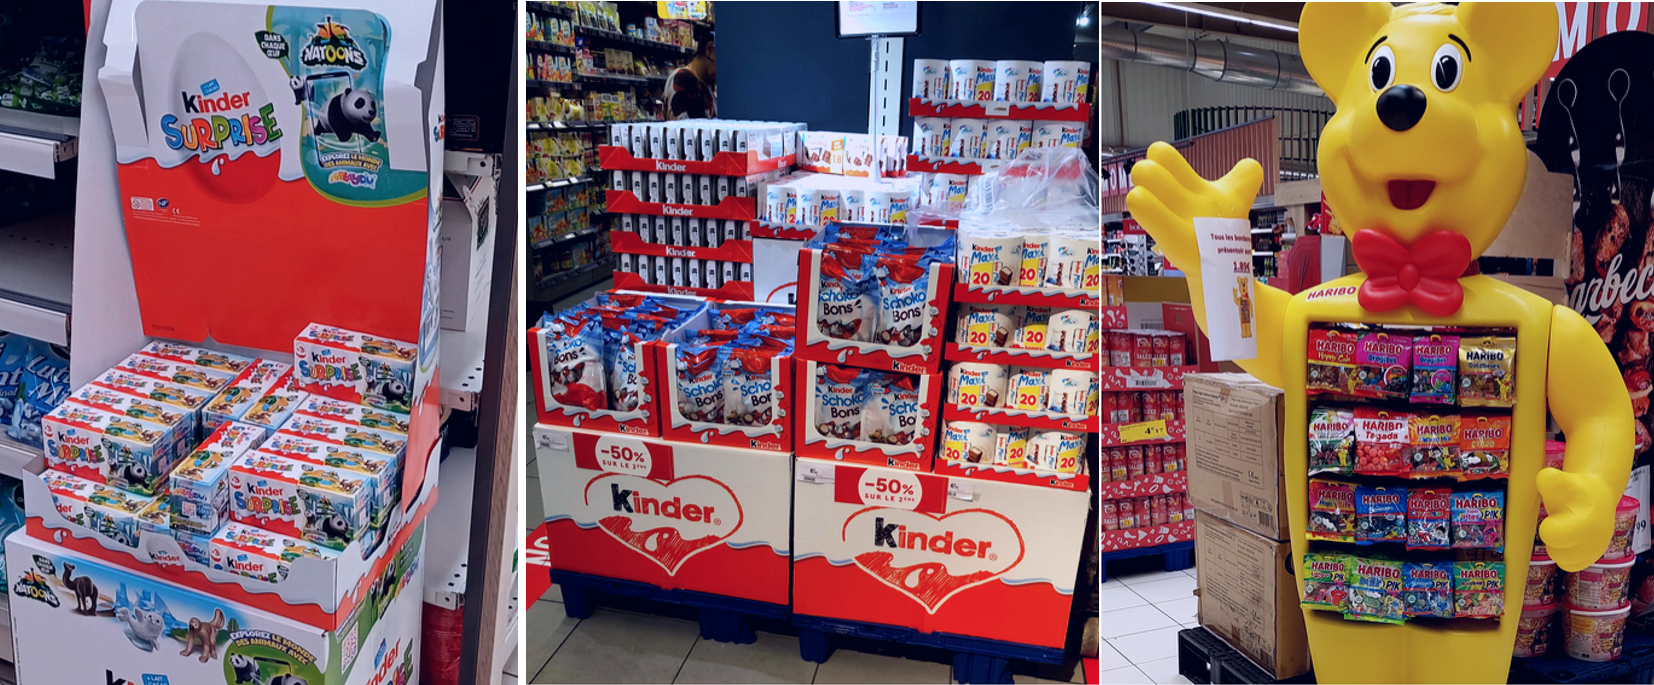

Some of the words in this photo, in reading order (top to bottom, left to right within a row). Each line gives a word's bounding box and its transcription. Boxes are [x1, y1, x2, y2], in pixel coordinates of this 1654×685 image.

[264, 33, 282, 42] DANS
[261, 41, 285, 51] CHAQUE
[303, 45, 365, 65] NATOONS
[161, 103, 283, 152] SURPRISE
[972, 272, 990, 285] 20
[1020, 267, 1036, 281] 20
[1307, 287, 1357, 300] HARIBO
[883, 291, 926, 310] Schoko
[823, 303, 854, 315] Bons
[893, 306, 922, 323] Bons
[970, 331, 987, 344] 20
[1026, 331, 1044, 344] 20
[1316, 340, 1356, 354] HARIBO
[1365, 341, 1403, 355] HARIBO
[1416, 345, 1451, 355] HARIBO
[1368, 354, 1397, 364] Dragibus
[1420, 356, 1446, 364] Dragibus
[1466, 352, 1504, 361] HARIBO
[300, 361, 363, 382] SURPRISE
[695, 390, 723, 408] Bons
[961, 394, 977, 406] 20
[1020, 394, 1037, 406] 20
[831, 406, 860, 418] Bons
[1314, 423, 1348, 431] HARIBO
[1362, 421, 1403, 431] HARIBO
[1416, 424, 1453, 435] HARIBO
[1464, 429, 1502, 439] HARIBO
[47, 440, 105, 464] SURPRISE
[601, 445, 645, 463] -50%
[946, 447, 960, 460] 20
[1009, 447, 1024, 459] 20
[602, 459, 617, 467] SUR
[1060, 457, 1075, 469] 20
[864, 477, 914, 496] -50%
[864, 492, 882, 500] SUR
[1318, 490, 1354, 501] HARIBO
[1363, 495, 1400, 505] HARIBO
[234, 491, 302, 516] SURPRISE
[1410, 500, 1448, 509] HARIBO
[1456, 498, 1497, 508] HARIBO
[1311, 562, 1344, 571] HARIBO
[1358, 565, 1400, 578] HARIBO
[1411, 570, 1447, 579] HARIBO
[1461, 570, 1497, 579] HARIBO
